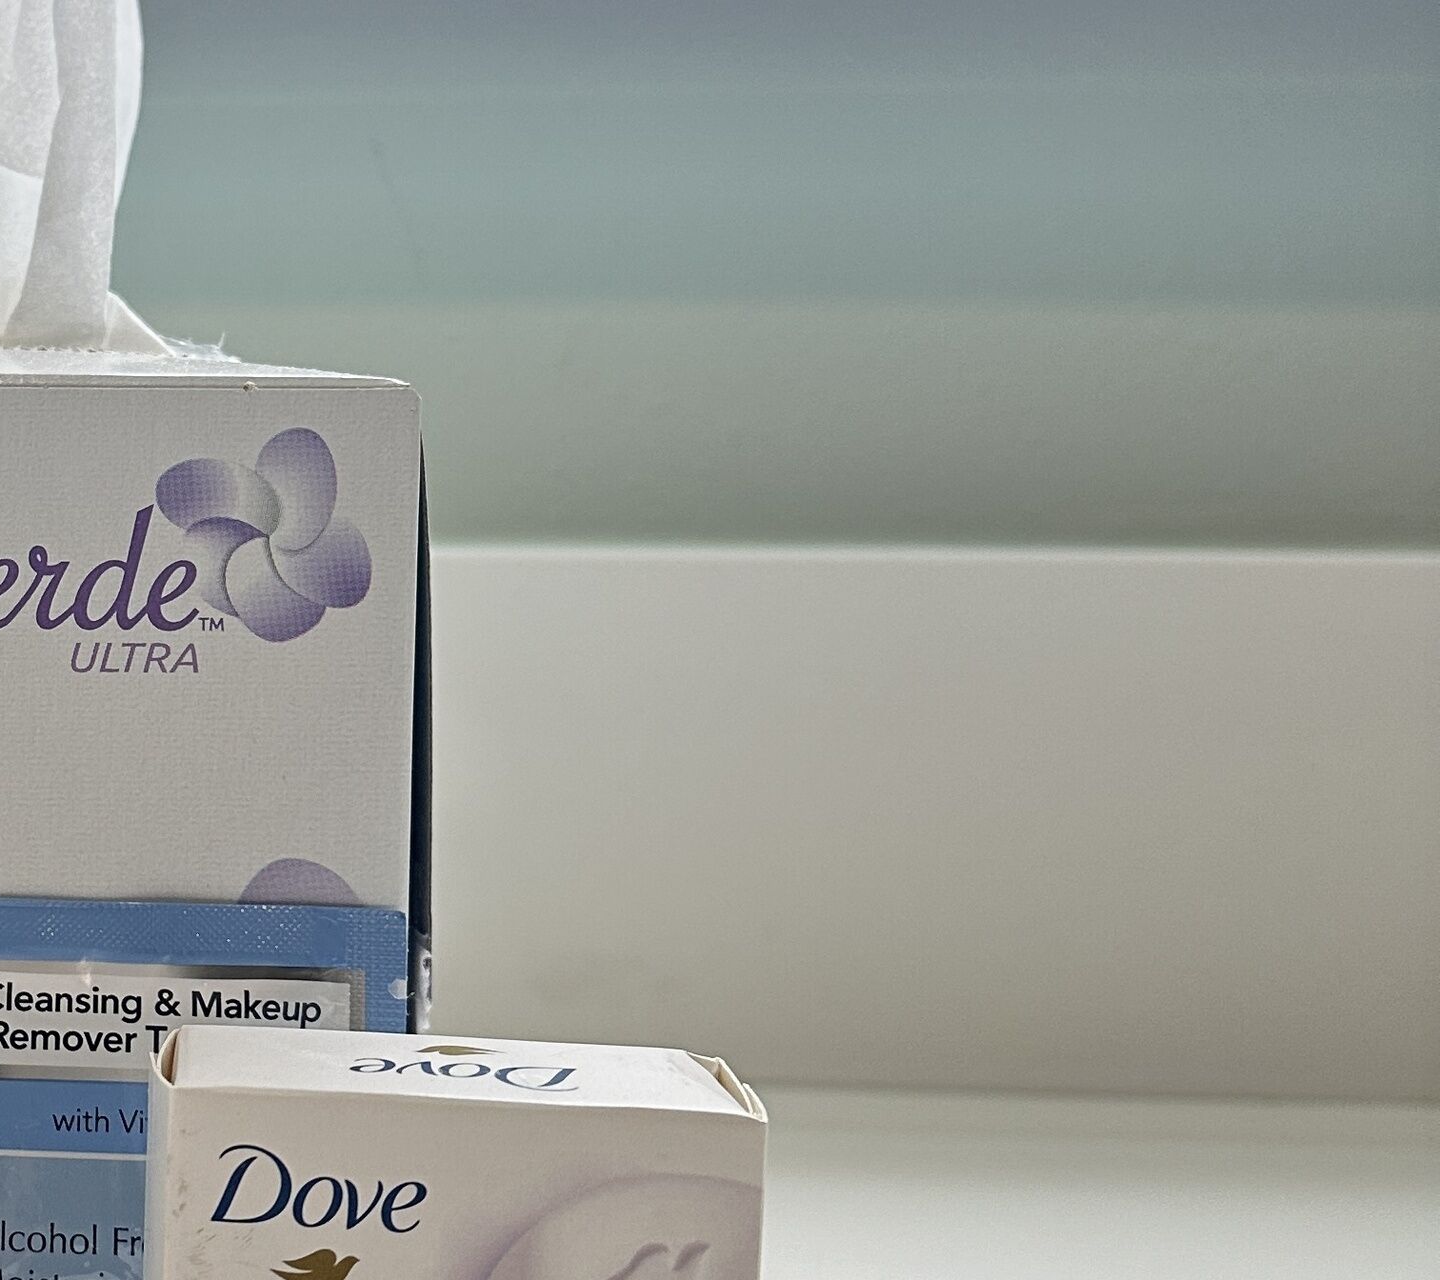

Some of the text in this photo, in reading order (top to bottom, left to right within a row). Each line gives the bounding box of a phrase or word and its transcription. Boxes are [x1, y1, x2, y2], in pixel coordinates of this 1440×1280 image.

[70, 642, 200, 674] ULTRA
[155, 990, 181, 1017] &
[191, 991, 322, 1028] Makeup
[350, 1057, 579, 1092] Dove
[52, 1106, 110, 1133] with
[210, 1144, 429, 1234] Dove
[113, 1227, 144, 1256] Fr
